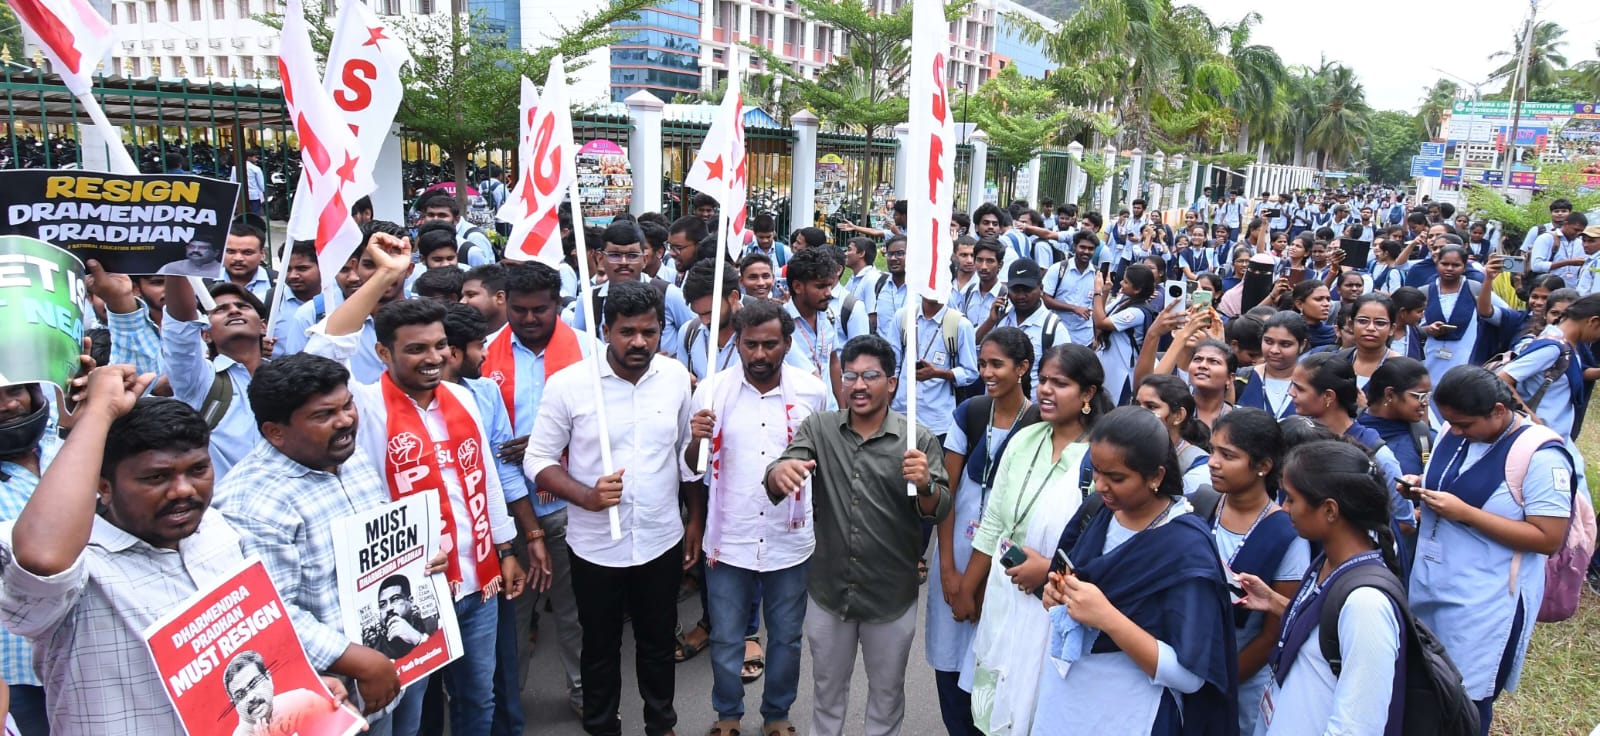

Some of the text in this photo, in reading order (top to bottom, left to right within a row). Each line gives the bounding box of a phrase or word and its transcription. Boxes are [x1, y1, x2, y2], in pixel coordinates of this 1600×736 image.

[45, 176, 200, 203] RESIGN
[8, 202, 217, 226] DRAMENDRA
[38, 223, 196, 244] PRADHAN
[365, 505, 408, 545] MUST
[464, 469, 491, 564] PDSU
[358, 524, 418, 574] RESIGN
[171, 585, 250, 649] DHARMENDRA
[191, 606, 245, 654] PRADHAN
[168, 600, 282, 698] MUST RESIGN
